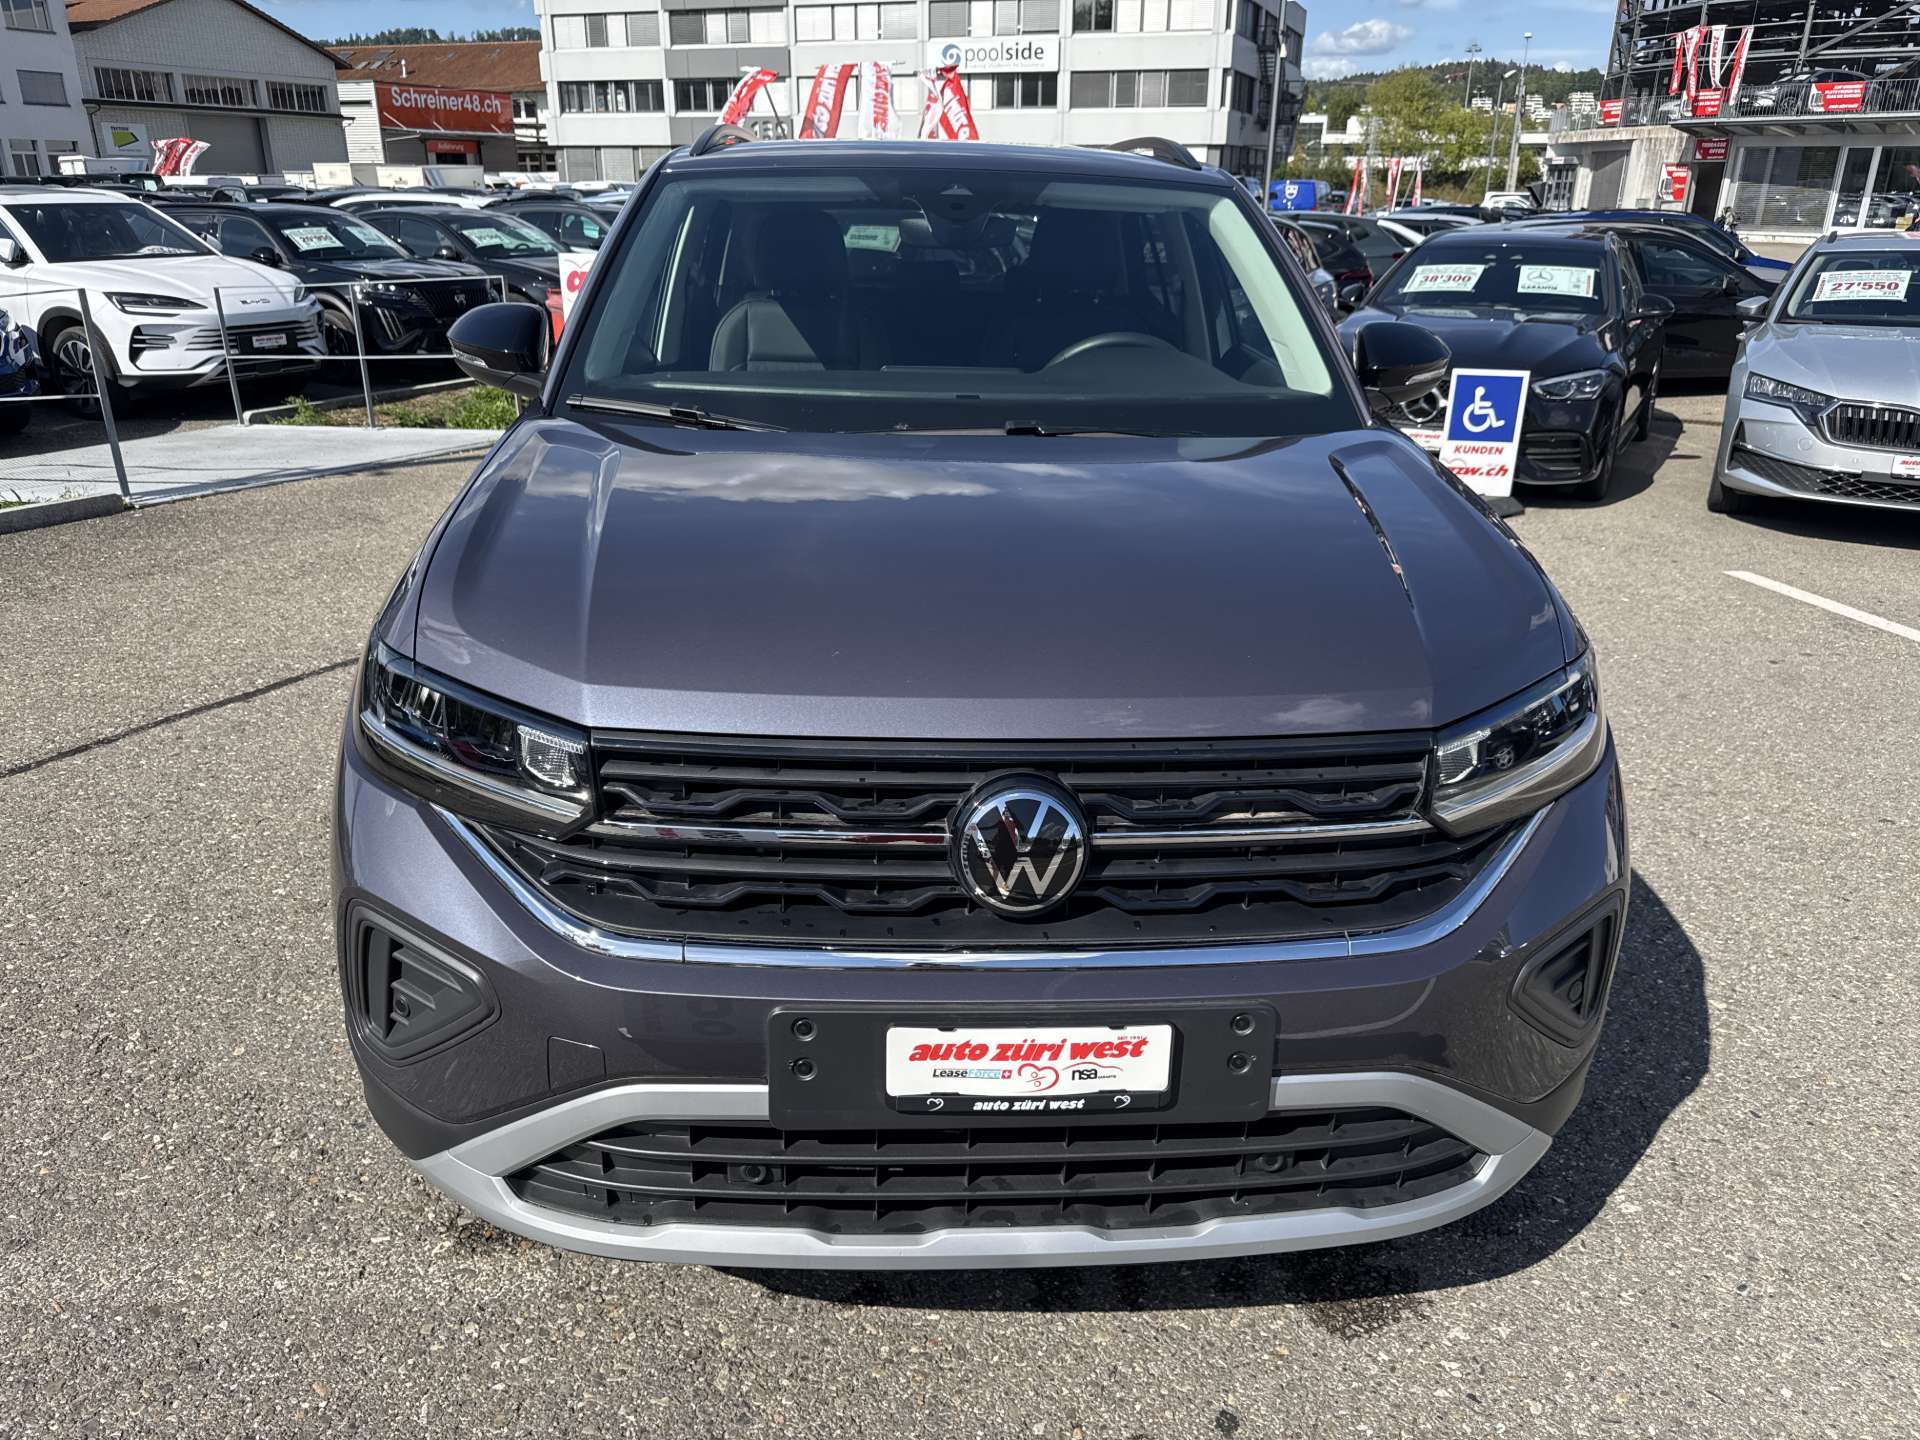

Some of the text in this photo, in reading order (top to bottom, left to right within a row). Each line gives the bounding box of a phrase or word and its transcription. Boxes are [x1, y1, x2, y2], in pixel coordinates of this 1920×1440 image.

[964, 41, 1044, 69] poolside
[391, 86, 501, 113] Schreiner48.ch
[1830, 281, 1900, 292] 27'550
[1454, 445, 1504, 455] KUNDEN
[908, 1037, 1149, 1062] auto züri west
[1072, 1069, 1098, 1081] nsa
[973, 1099, 1085, 1111] auto züri west
